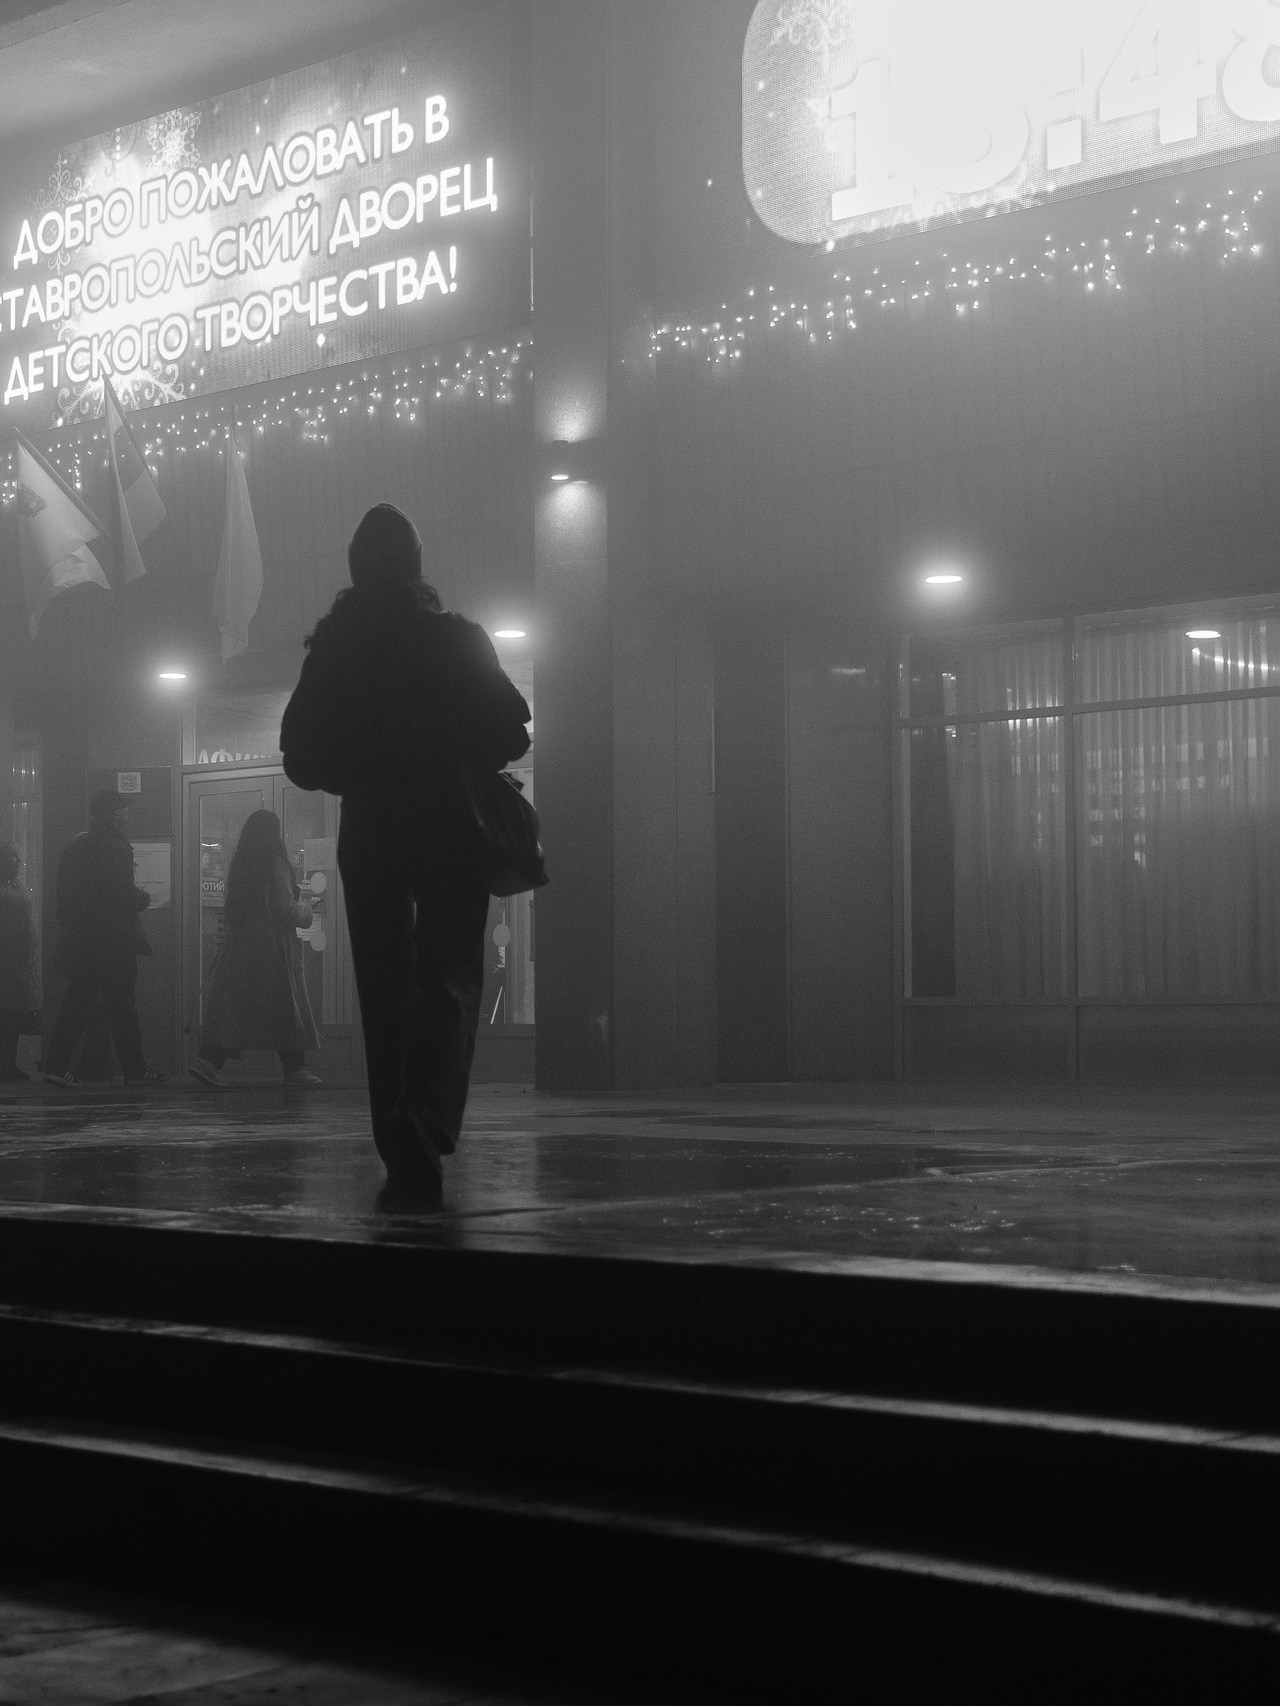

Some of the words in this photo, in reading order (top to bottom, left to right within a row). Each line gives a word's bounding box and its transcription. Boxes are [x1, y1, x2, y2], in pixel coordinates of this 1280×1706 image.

[12, 190, 133, 269] ДОБРО
[140, 108, 414, 229] ПОЖАЛОВАТЬ
[425, 95, 451, 144] В
[328, 157, 498, 254] ДВОРЕЦ
[3, 316, 188, 404] ДЕТСКОГО
[196, 246, 458, 352] ТВОРЧЕСТВА!
